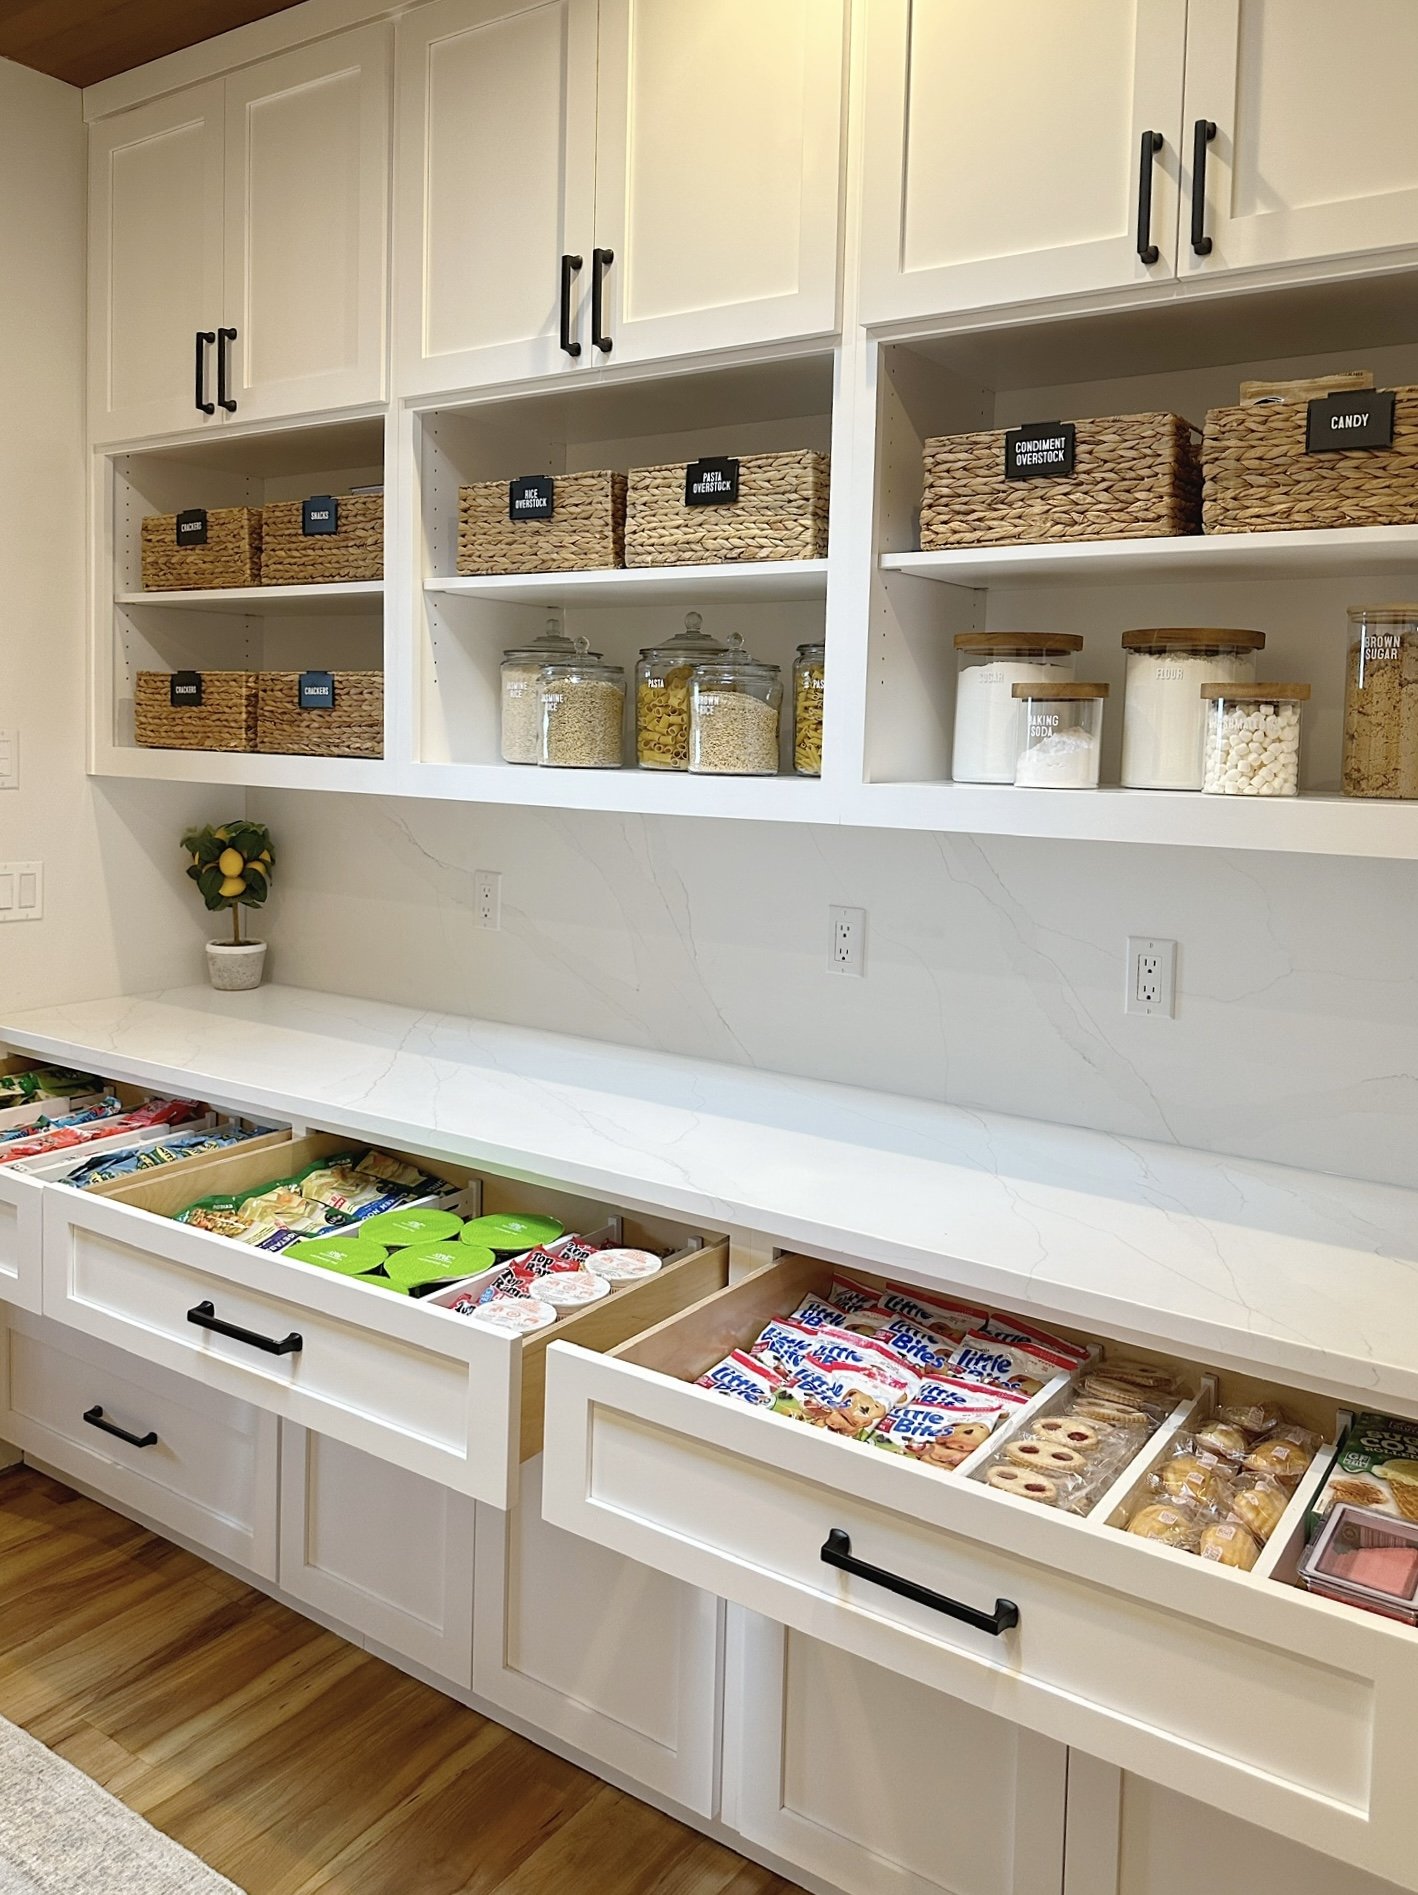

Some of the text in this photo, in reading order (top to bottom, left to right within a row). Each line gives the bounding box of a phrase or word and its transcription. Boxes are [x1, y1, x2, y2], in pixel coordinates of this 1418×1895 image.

[1331, 413, 1369, 430] CANDY
[1015, 437, 1066, 453] CONDIMENT
[1016, 450, 1065, 466] OVERSTOCK
[703, 471, 722, 483] PASTA
[692, 480, 731, 494] OVERSTOCK
[524, 488, 538, 499] RICE
[515, 497, 547, 509] OVERSTOCK
[310, 510, 329, 520] SNACKS
[181, 521, 202, 532] CRACKERS
[1363, 636, 1400, 648] BROWN
[1365, 648, 1398, 660] SUGAR
[1156, 668, 1184, 680] FLOUR
[175, 685, 197, 694] CRACKERS
[648, 679, 665, 688] PASTA
[304, 686, 329, 696] CRACKERS
[1029, 714, 1060, 727] AKING
[1031, 726, 1053, 737] SODA
[530, 1251, 555, 1267] Top
[891, 1332, 945, 1370] Bites
[711, 1365, 766, 1395] Little
[893, 1417, 956, 1438] Bites
